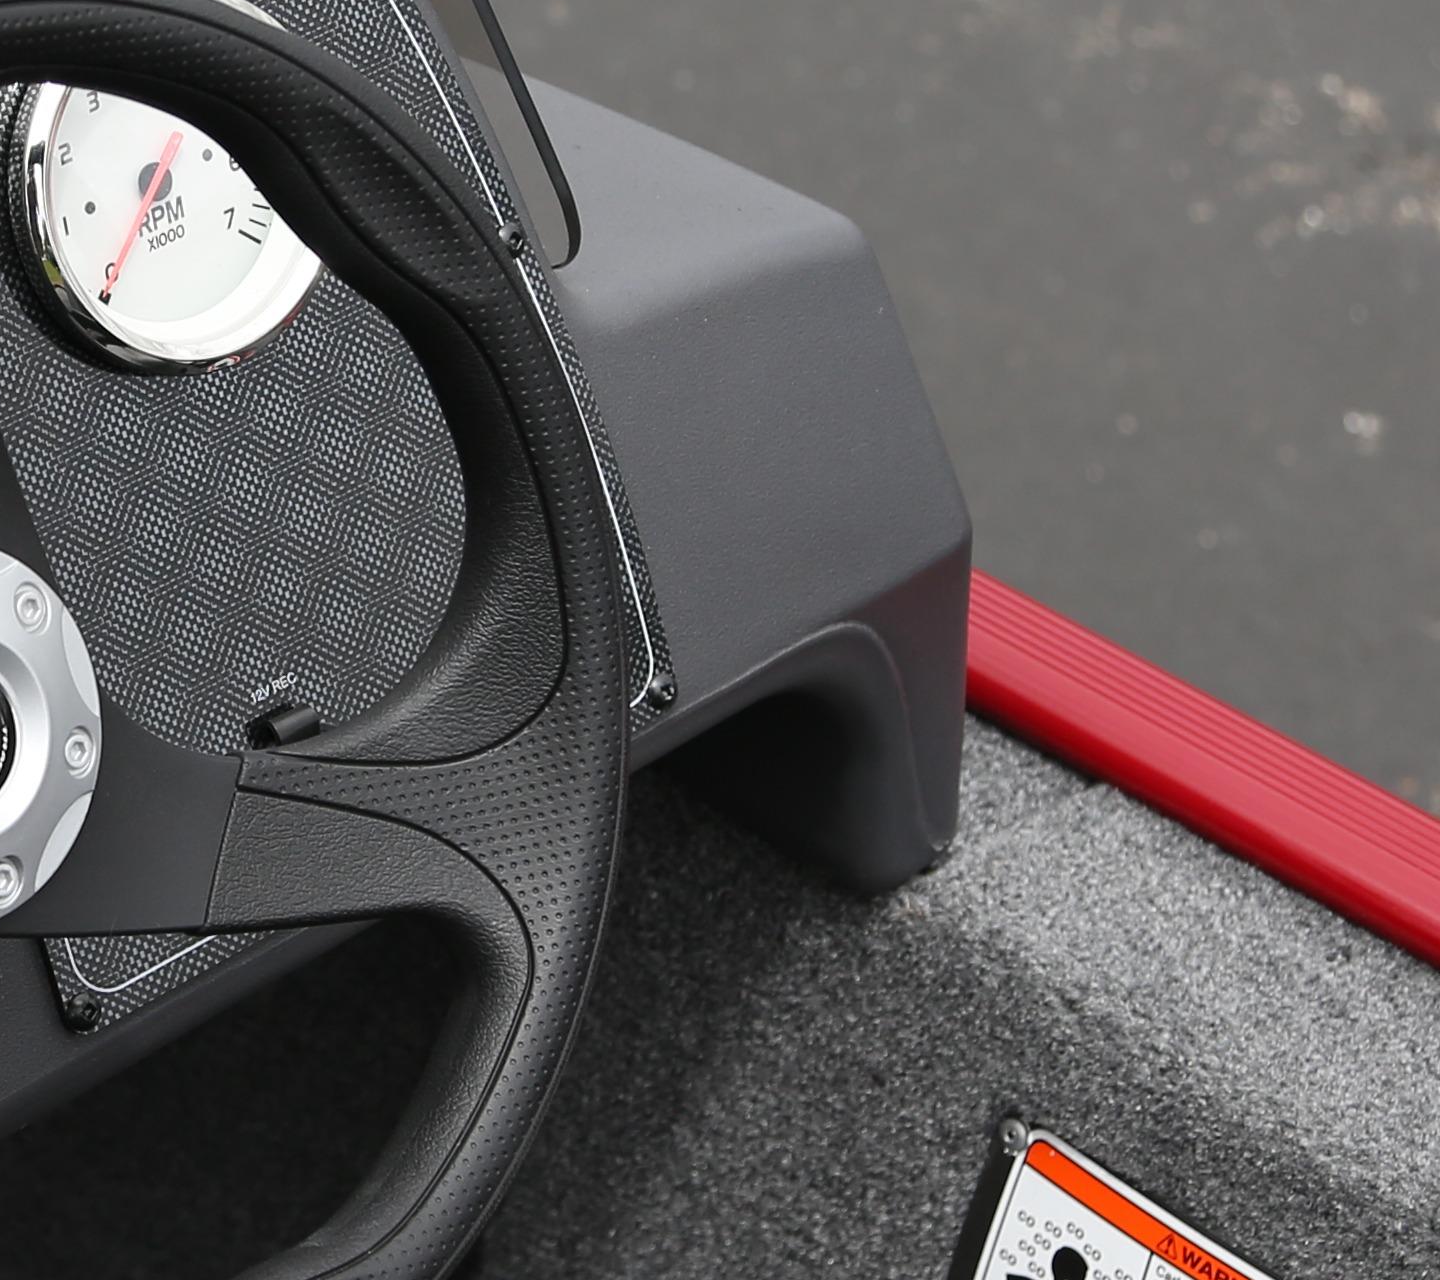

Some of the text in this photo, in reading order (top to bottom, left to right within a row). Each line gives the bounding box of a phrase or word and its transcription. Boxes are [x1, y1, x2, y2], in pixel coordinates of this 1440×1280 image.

[58, 142, 73, 166] 2
[137, 195, 186, 237] RPM
[223, 207, 235, 230] 7
[250, 671, 297, 704] 12V REC
